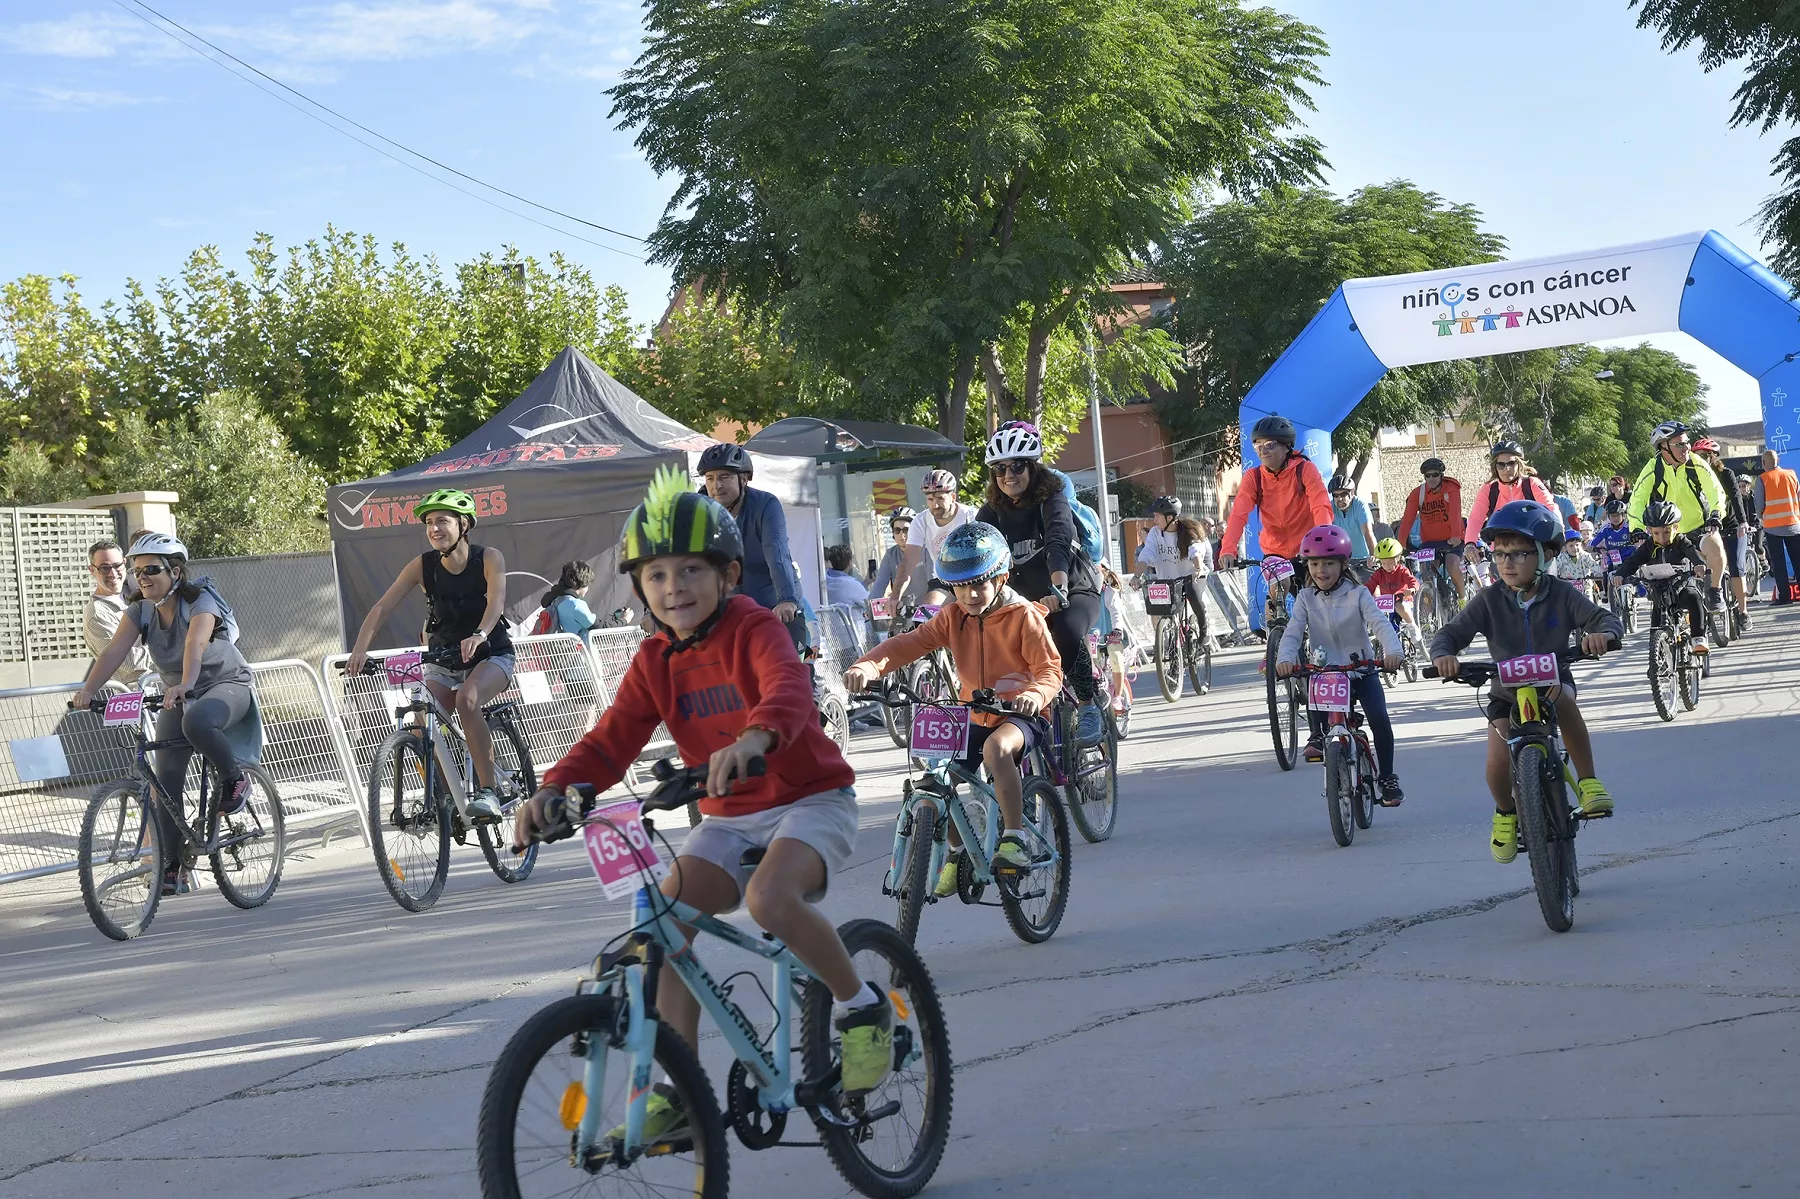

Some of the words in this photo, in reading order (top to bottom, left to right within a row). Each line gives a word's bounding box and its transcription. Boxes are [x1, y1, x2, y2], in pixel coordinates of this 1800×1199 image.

[1488, 279, 1535, 299] con
[1543, 265, 1632, 292] cáncer
[1526, 295, 1637, 326] ASPANOA
[420, 446, 621, 476] INMETAES
[361, 490, 508, 529] INMES
[1013, 539, 1037, 556] NIKE
[1149, 589, 1167, 597] 1622
[1501, 656, 1553, 678] 1518
[1311, 682, 1347, 697] 1515
[108, 699, 140, 713] 1656
[676, 683, 746, 721] PUMA
[916, 719, 966, 740] 1537
